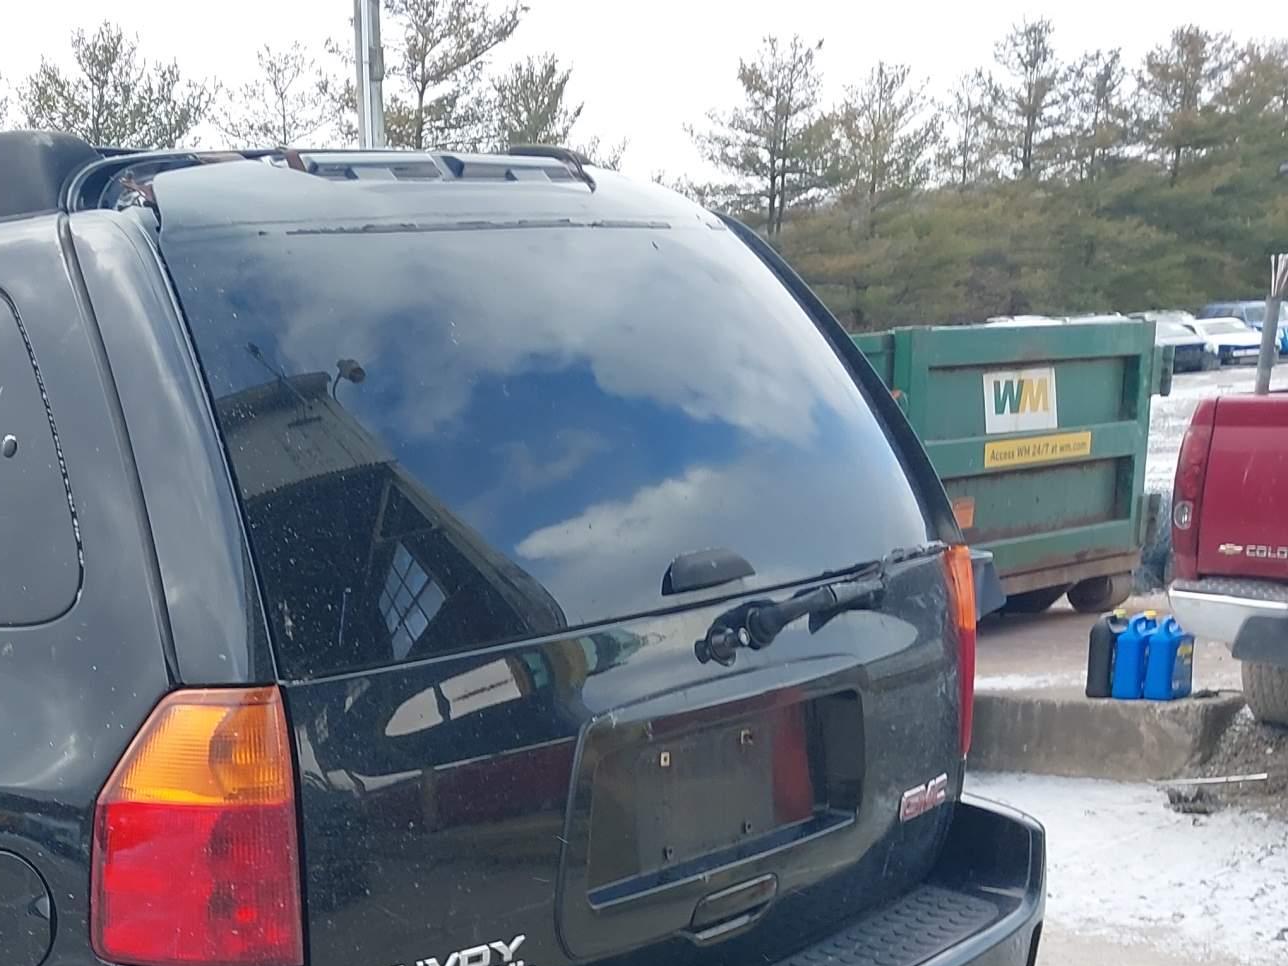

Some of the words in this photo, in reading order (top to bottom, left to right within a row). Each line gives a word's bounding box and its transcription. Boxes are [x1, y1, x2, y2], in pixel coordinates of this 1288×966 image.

[993, 378, 1049, 415] WM
[990, 448, 1015, 461] Access
[1017, 445, 1031, 458] WM
[1032, 443, 1050, 456] 24/7
[1051, 443, 1058, 453] at
[1059, 441, 1087, 452] wm.com
[900, 772, 948, 822] GMC
